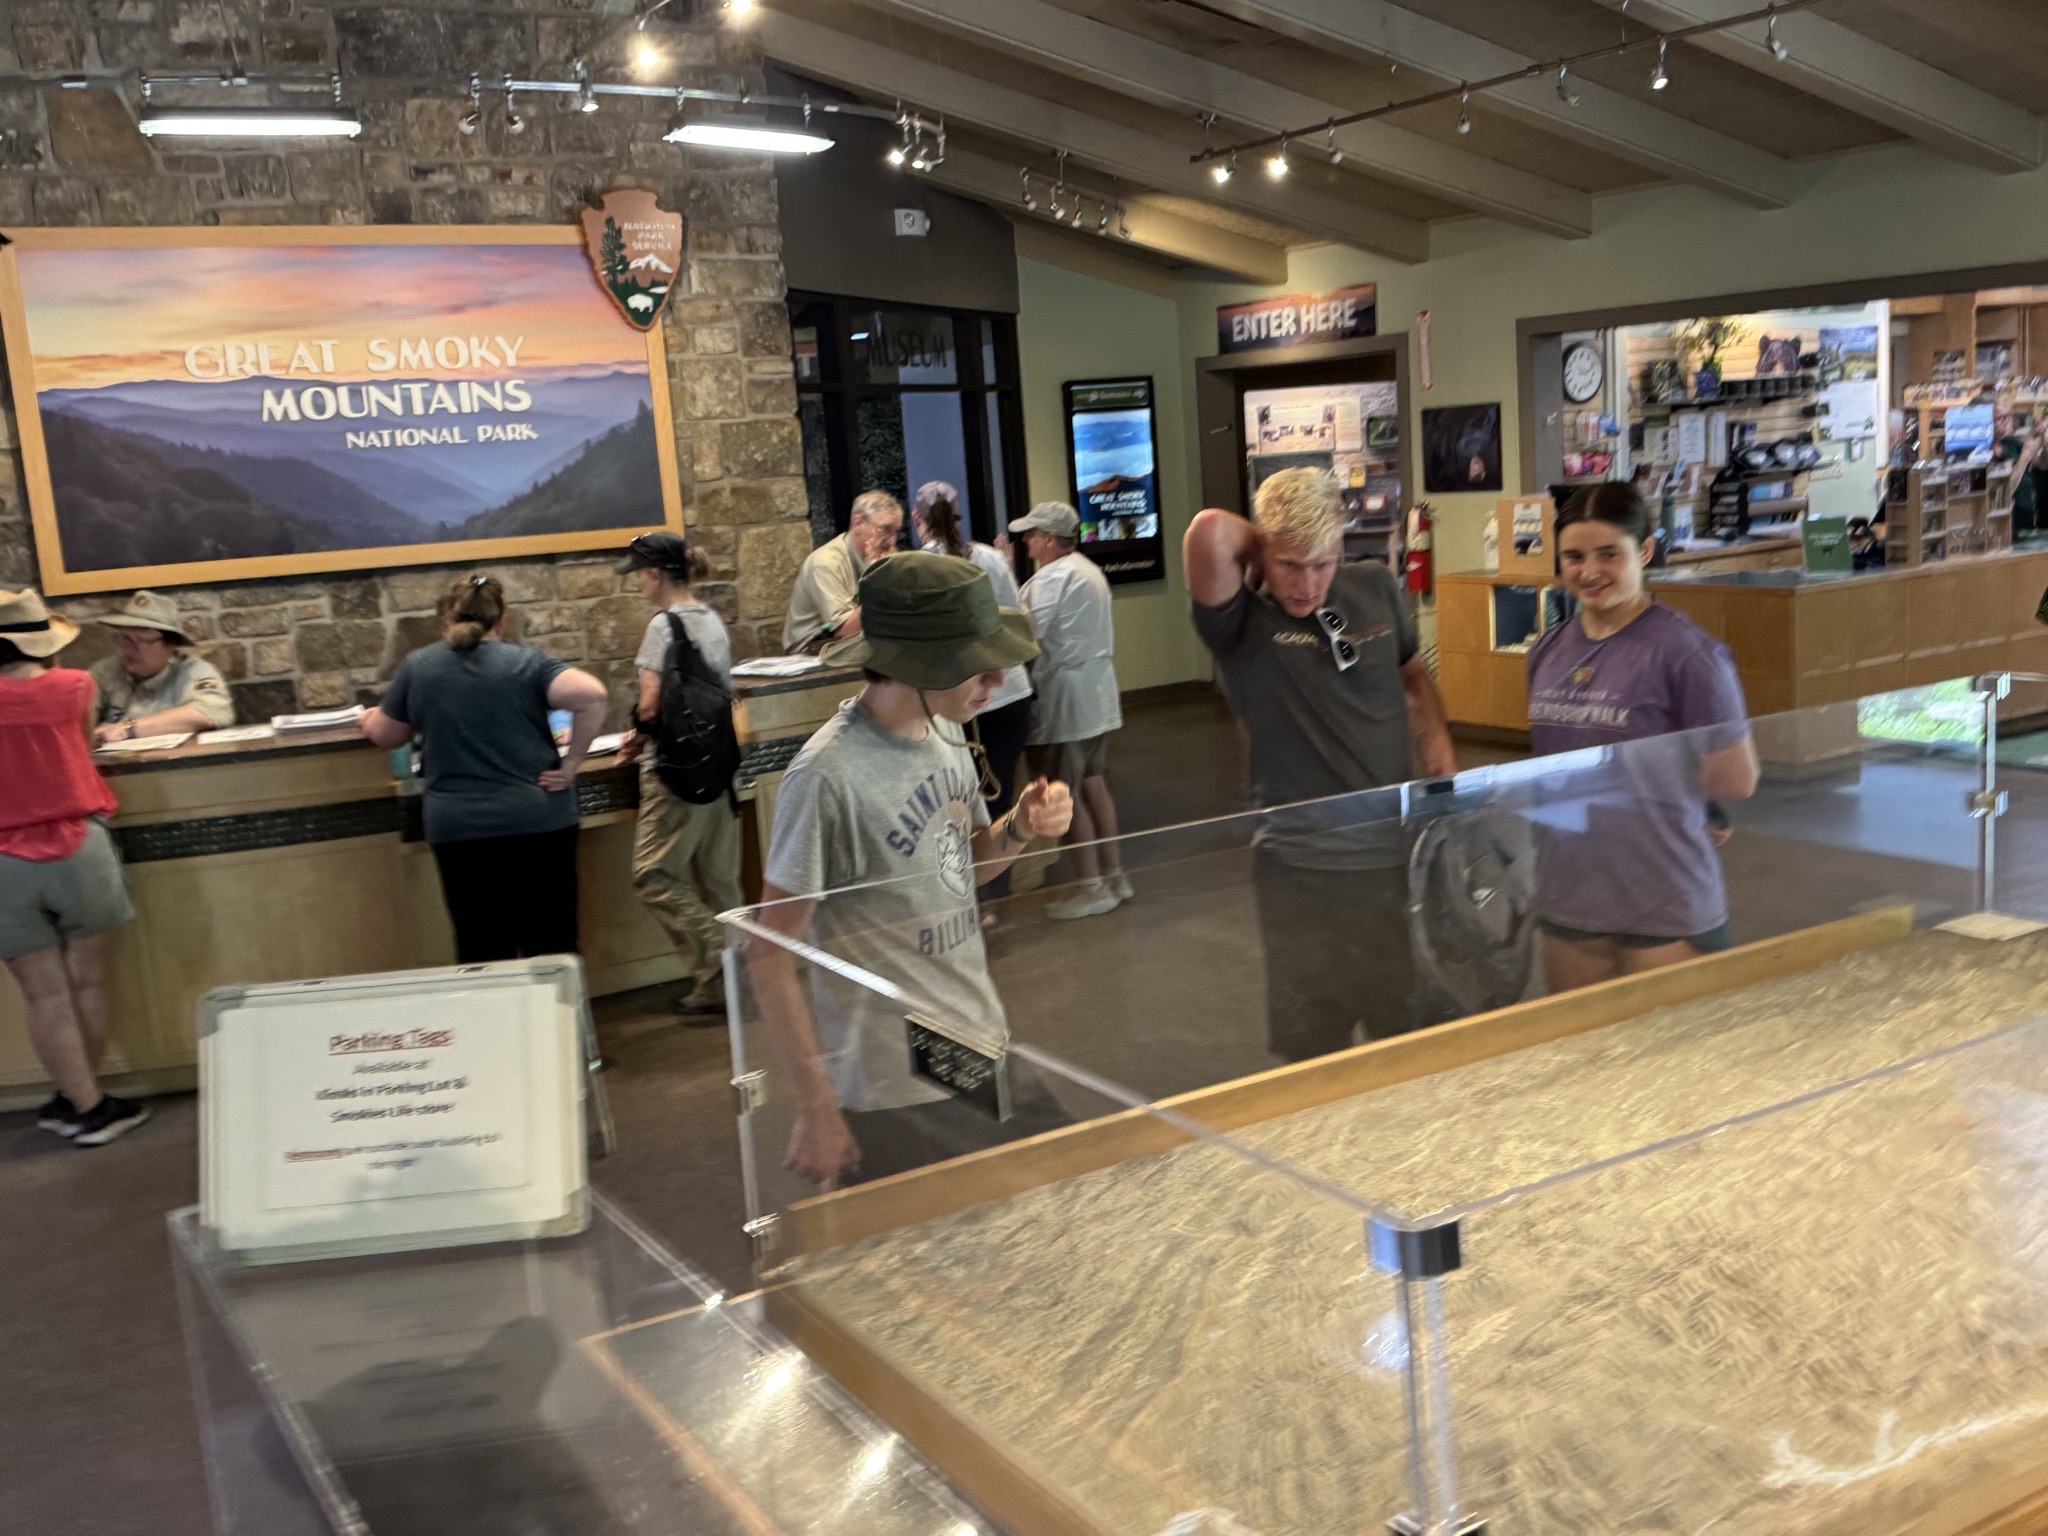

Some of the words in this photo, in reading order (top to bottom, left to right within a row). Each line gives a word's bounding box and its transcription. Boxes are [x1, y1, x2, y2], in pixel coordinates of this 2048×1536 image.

[1231, 306, 1297, 343] ENTER
[1300, 297, 1358, 335] HERE
[184, 338, 342, 379] GREAT
[366, 335, 525, 373] SMOKY
[868, 331, 948, 369] MUSEUM
[261, 378, 534, 423] MOUNTAINS
[345, 425, 469, 450] NATIONAL
[477, 422, 540, 444] PARK
[885, 769, 942, 859] SAINT
[328, 1031, 403, 1053] Parking
[403, 1026, 455, 1049] Tags
